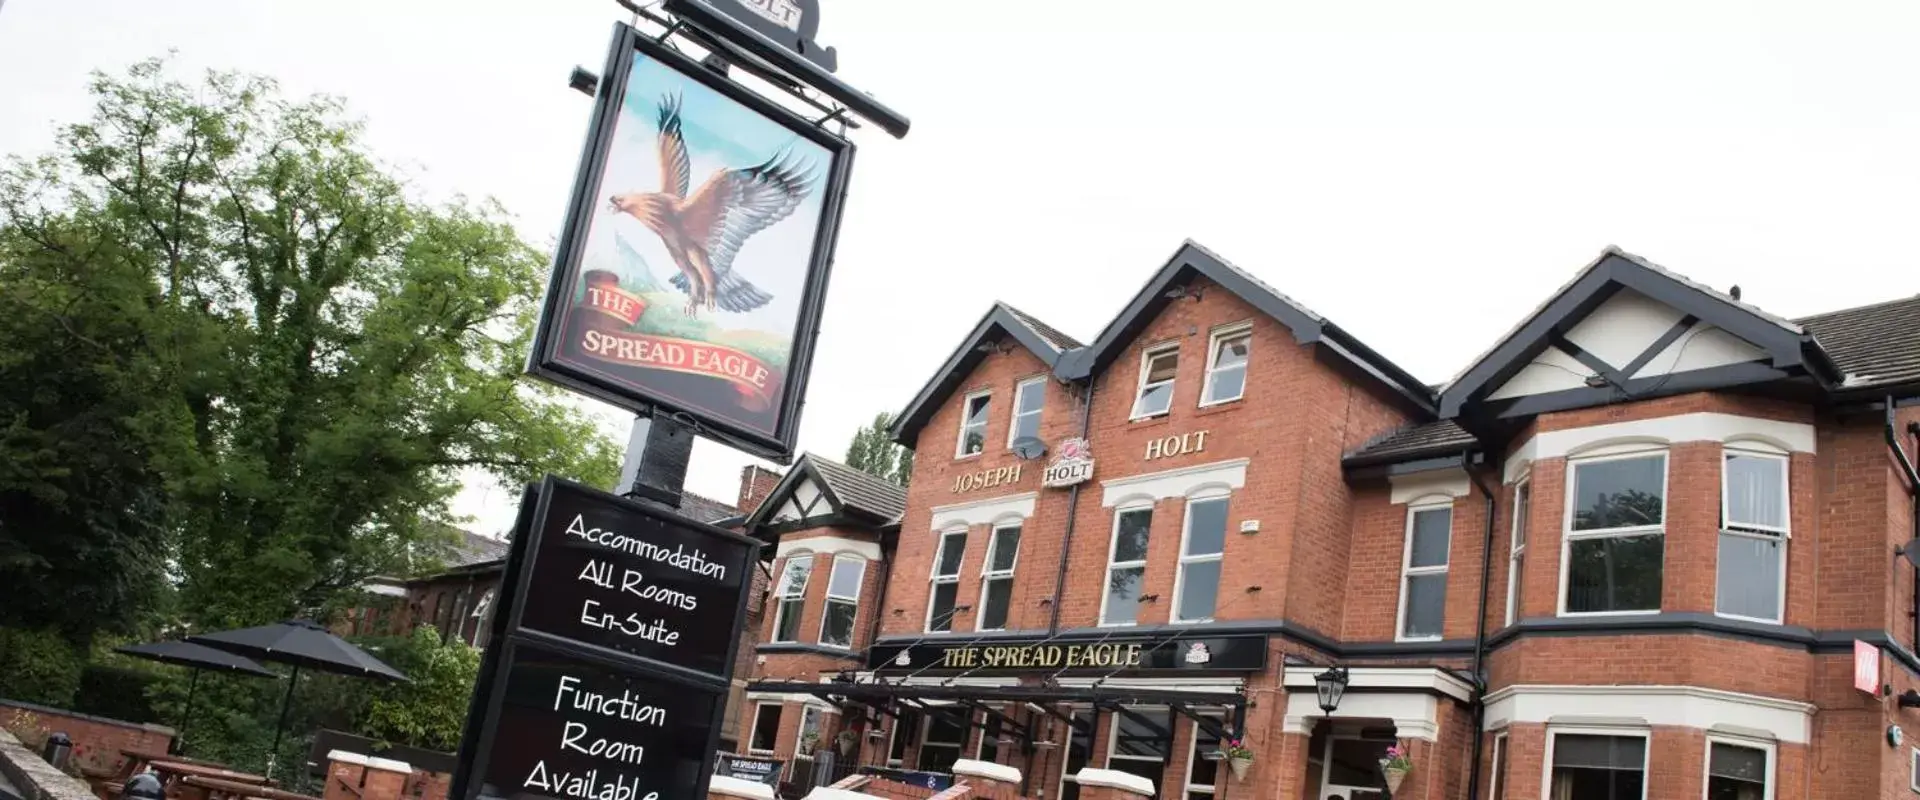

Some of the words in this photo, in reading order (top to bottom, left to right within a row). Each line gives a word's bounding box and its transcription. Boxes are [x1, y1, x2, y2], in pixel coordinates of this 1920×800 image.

[588, 287, 633, 318] THE
[582, 330, 685, 366] SPREAD
[692, 349, 769, 388] EAGLE
[952, 464, 1022, 494] JOSEPH
[1144, 430, 1210, 461] HOLT
[1045, 463, 1091, 482] HOLT
[564, 513, 726, 582] Accommodation
[620, 569, 698, 612] Rooms
[580, 599, 680, 647] En-Suite
[943, 648, 978, 667] THE
[981, 645, 1062, 667] SPREAD
[1066, 643, 1142, 667] EAGLE
[553, 675, 666, 728] Function
[560, 720, 645, 766] Room
